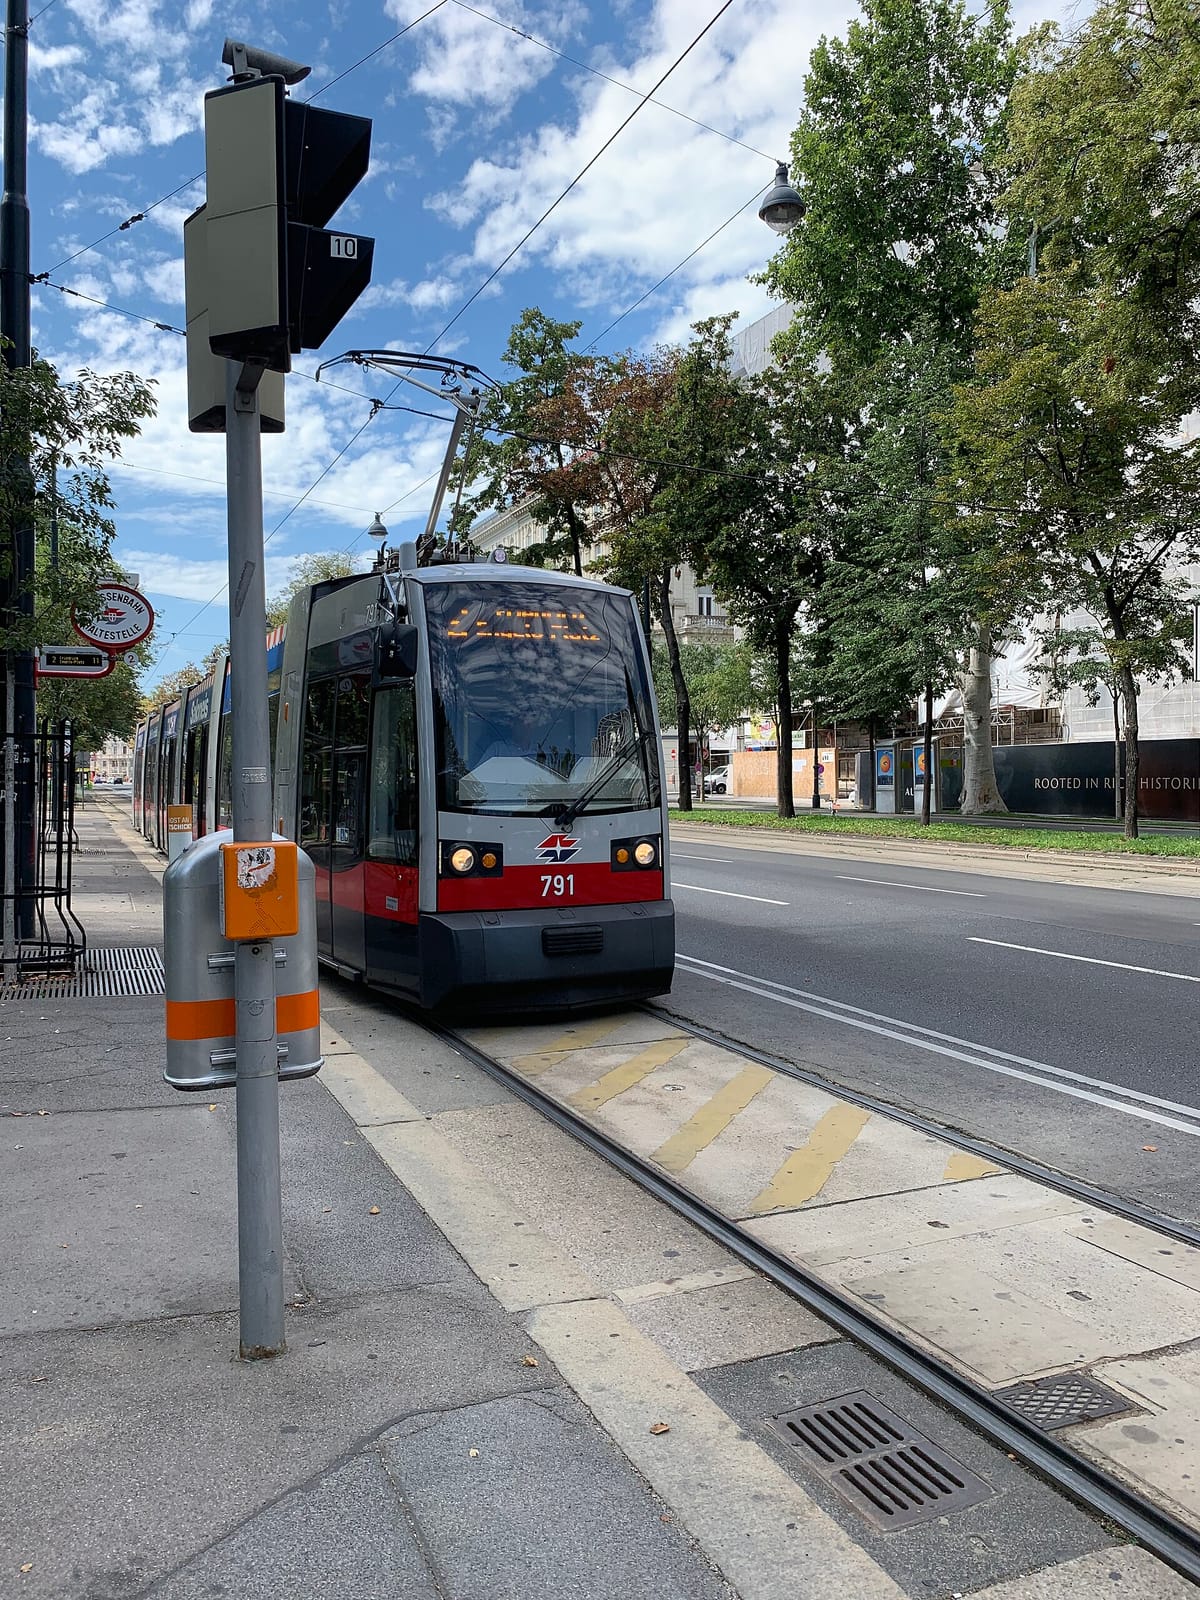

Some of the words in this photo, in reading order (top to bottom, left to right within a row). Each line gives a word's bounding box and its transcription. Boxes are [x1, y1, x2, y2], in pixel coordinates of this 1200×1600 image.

[335, 239, 355, 257] 10
[128, 655, 136, 663] 2
[1034, 777, 1081, 790] ROOTED
[1085, 777, 1099, 789] IN
[1104, 777, 1125, 790] RIC
[541, 874, 574, 897] 791
